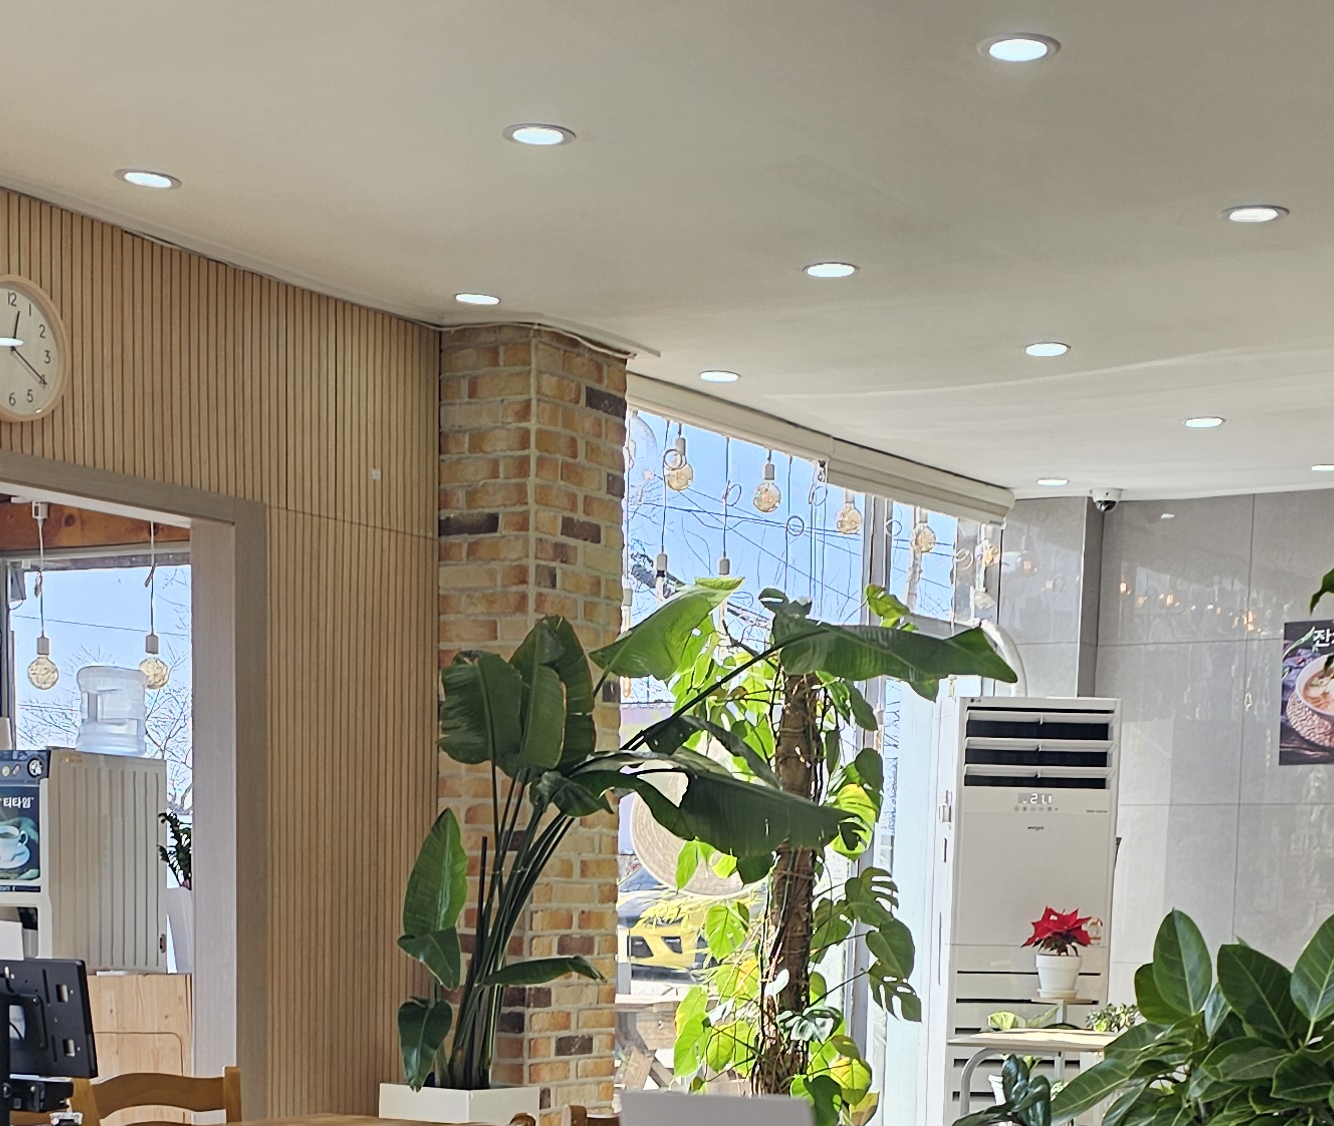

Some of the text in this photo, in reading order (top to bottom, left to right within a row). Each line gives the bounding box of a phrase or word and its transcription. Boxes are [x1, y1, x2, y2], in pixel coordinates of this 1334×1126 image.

[7, 291, 18, 307] 12
[39, 324, 46, 339] 2
[44, 350, 52, 364] 3
[8, 392, 16, 406] 6
[26, 389, 34, 403] 5
[3, 796, 32, 809] 티타임
